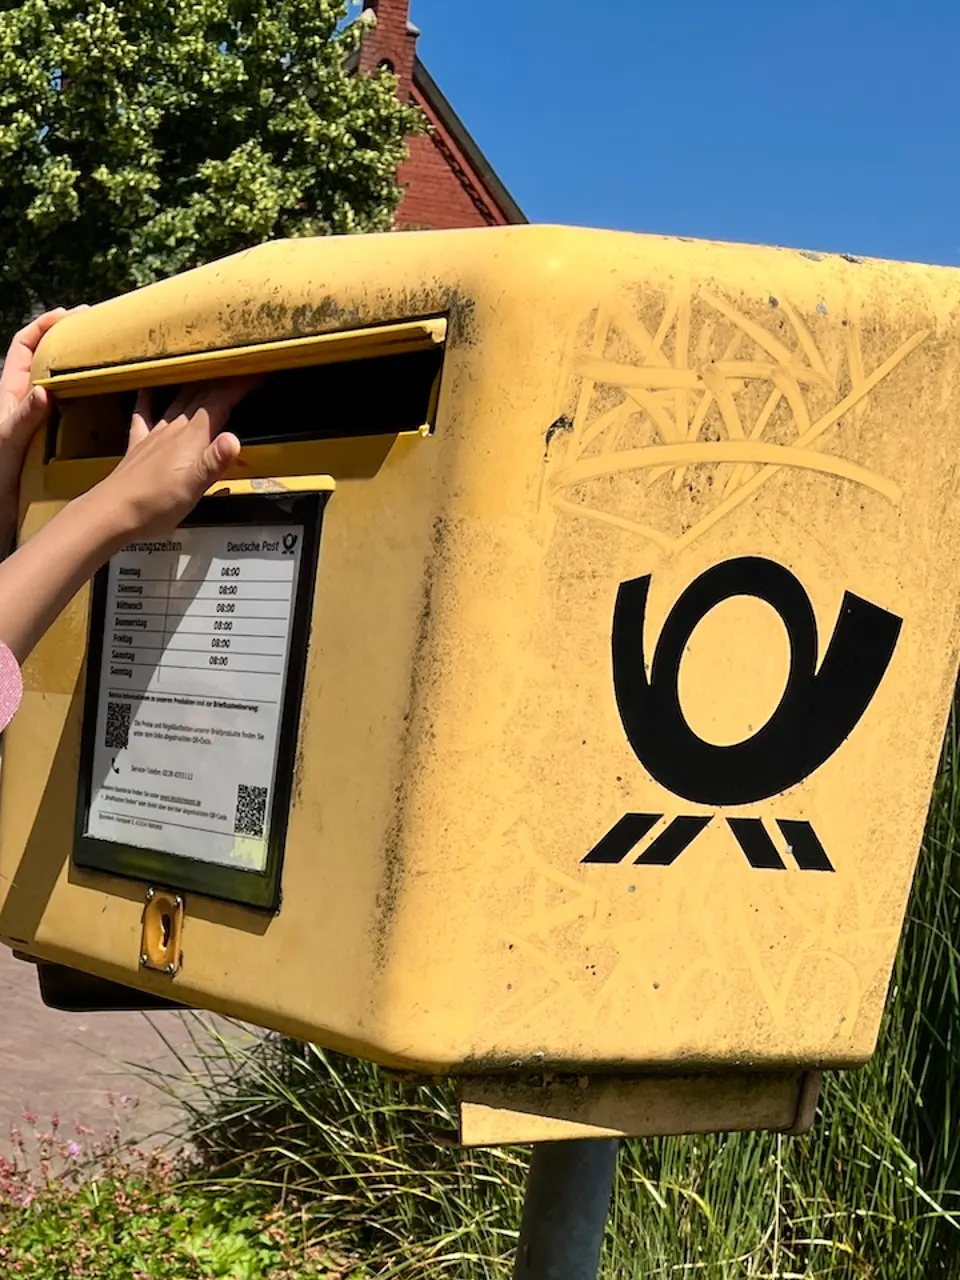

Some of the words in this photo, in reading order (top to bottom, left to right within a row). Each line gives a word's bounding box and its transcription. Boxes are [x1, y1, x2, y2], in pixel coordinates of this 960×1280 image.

[120, 540, 182, 555] eerungszeiten
[227, 540, 260, 552] Deutsche
[261, 540, 280, 552] Post
[119, 567, 141, 578] Montag
[221, 567, 240, 576] 08:00
[118, 584, 143, 595] Dienstag
[218, 585, 237, 595] 08:00
[116, 600, 142, 610] Mittwoch
[216, 603, 235, 612] 08:00
[116, 617, 147, 629] Donnerstag
[213, 621, 232, 630] 08:00
[113, 633, 133, 645] Freitag
[211, 638, 230, 648] 08:00
[111, 650, 135, 662] Samstag
[209, 656, 228, 666] 08:00
[110, 666, 133, 678] Sonntag
